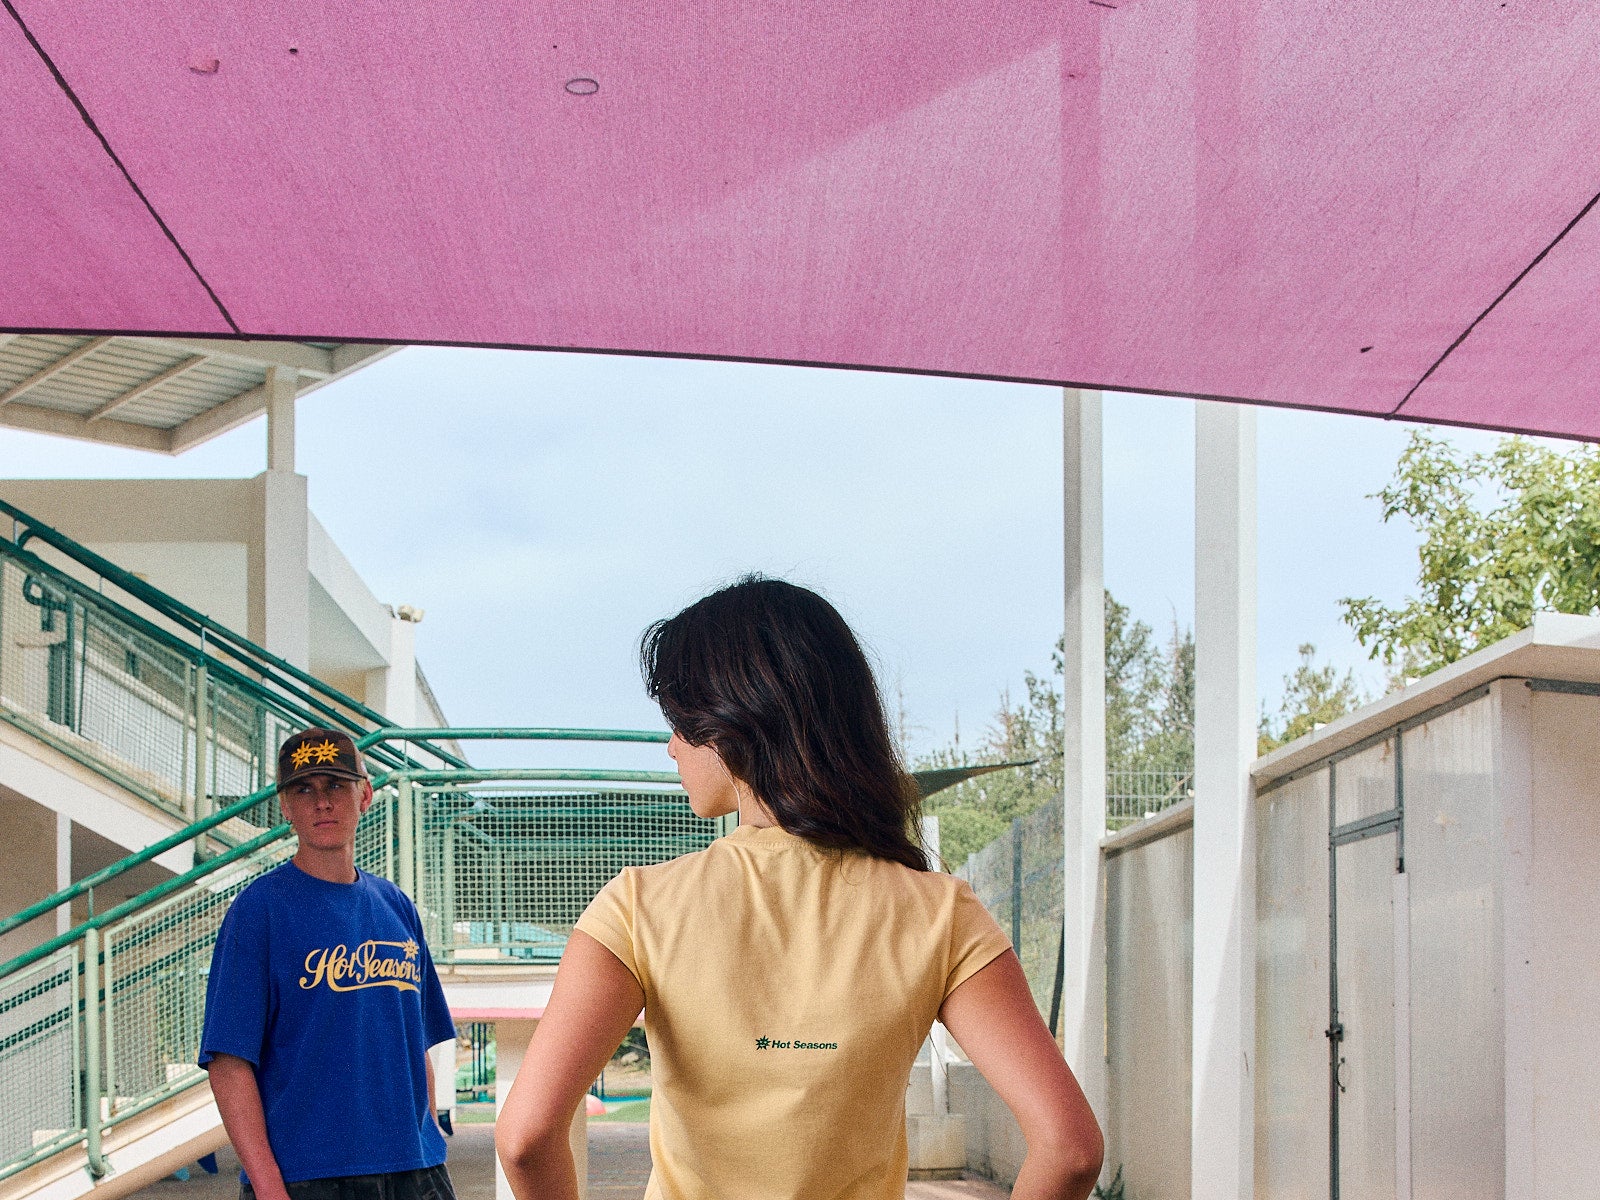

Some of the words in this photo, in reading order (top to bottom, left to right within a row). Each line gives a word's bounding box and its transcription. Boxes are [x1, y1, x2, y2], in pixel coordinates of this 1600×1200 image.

[299, 944, 356, 992] Hot
[771, 1040, 791, 1049] Hot
[793, 1040, 838, 1050] Seasons
